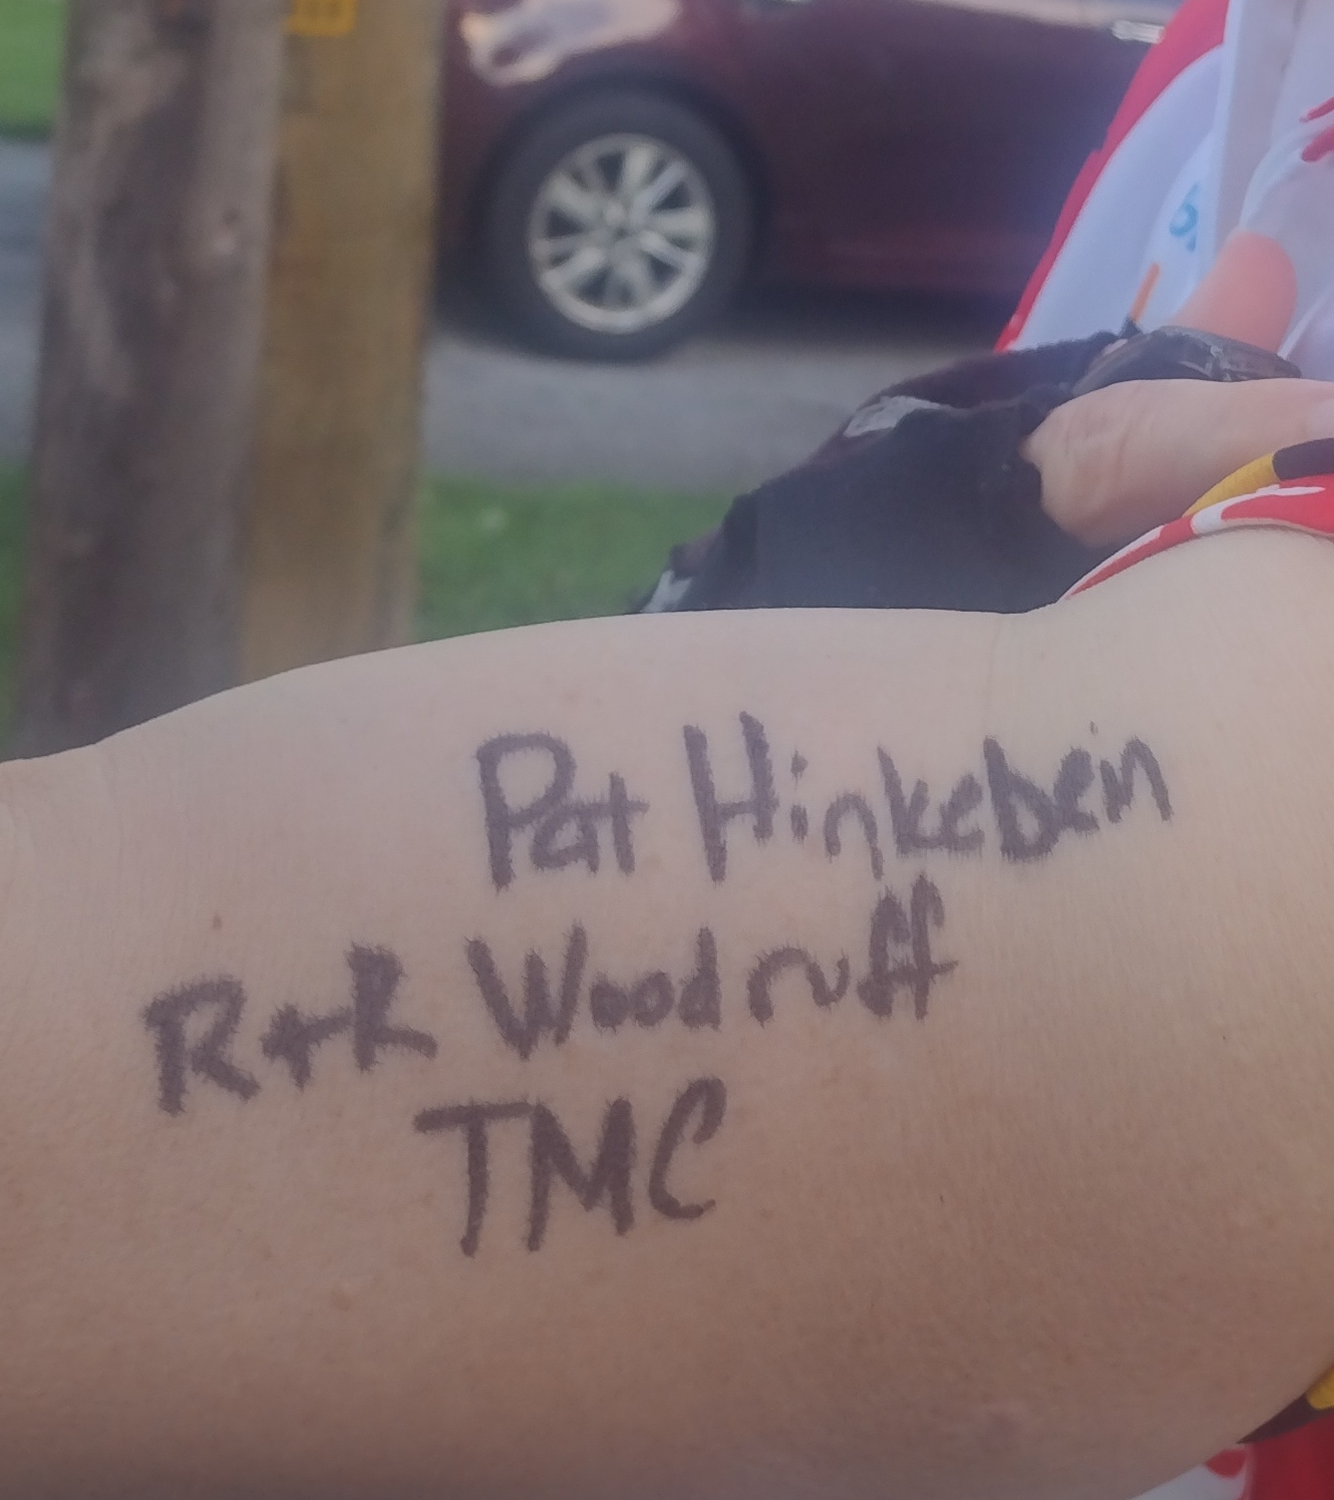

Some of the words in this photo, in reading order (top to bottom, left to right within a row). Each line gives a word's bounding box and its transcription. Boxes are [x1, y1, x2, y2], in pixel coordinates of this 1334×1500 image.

[476, 732, 648, 891] Pat
[468, 874, 959, 1059] Woodruff
[414, 1078, 726, 1256] TMC
